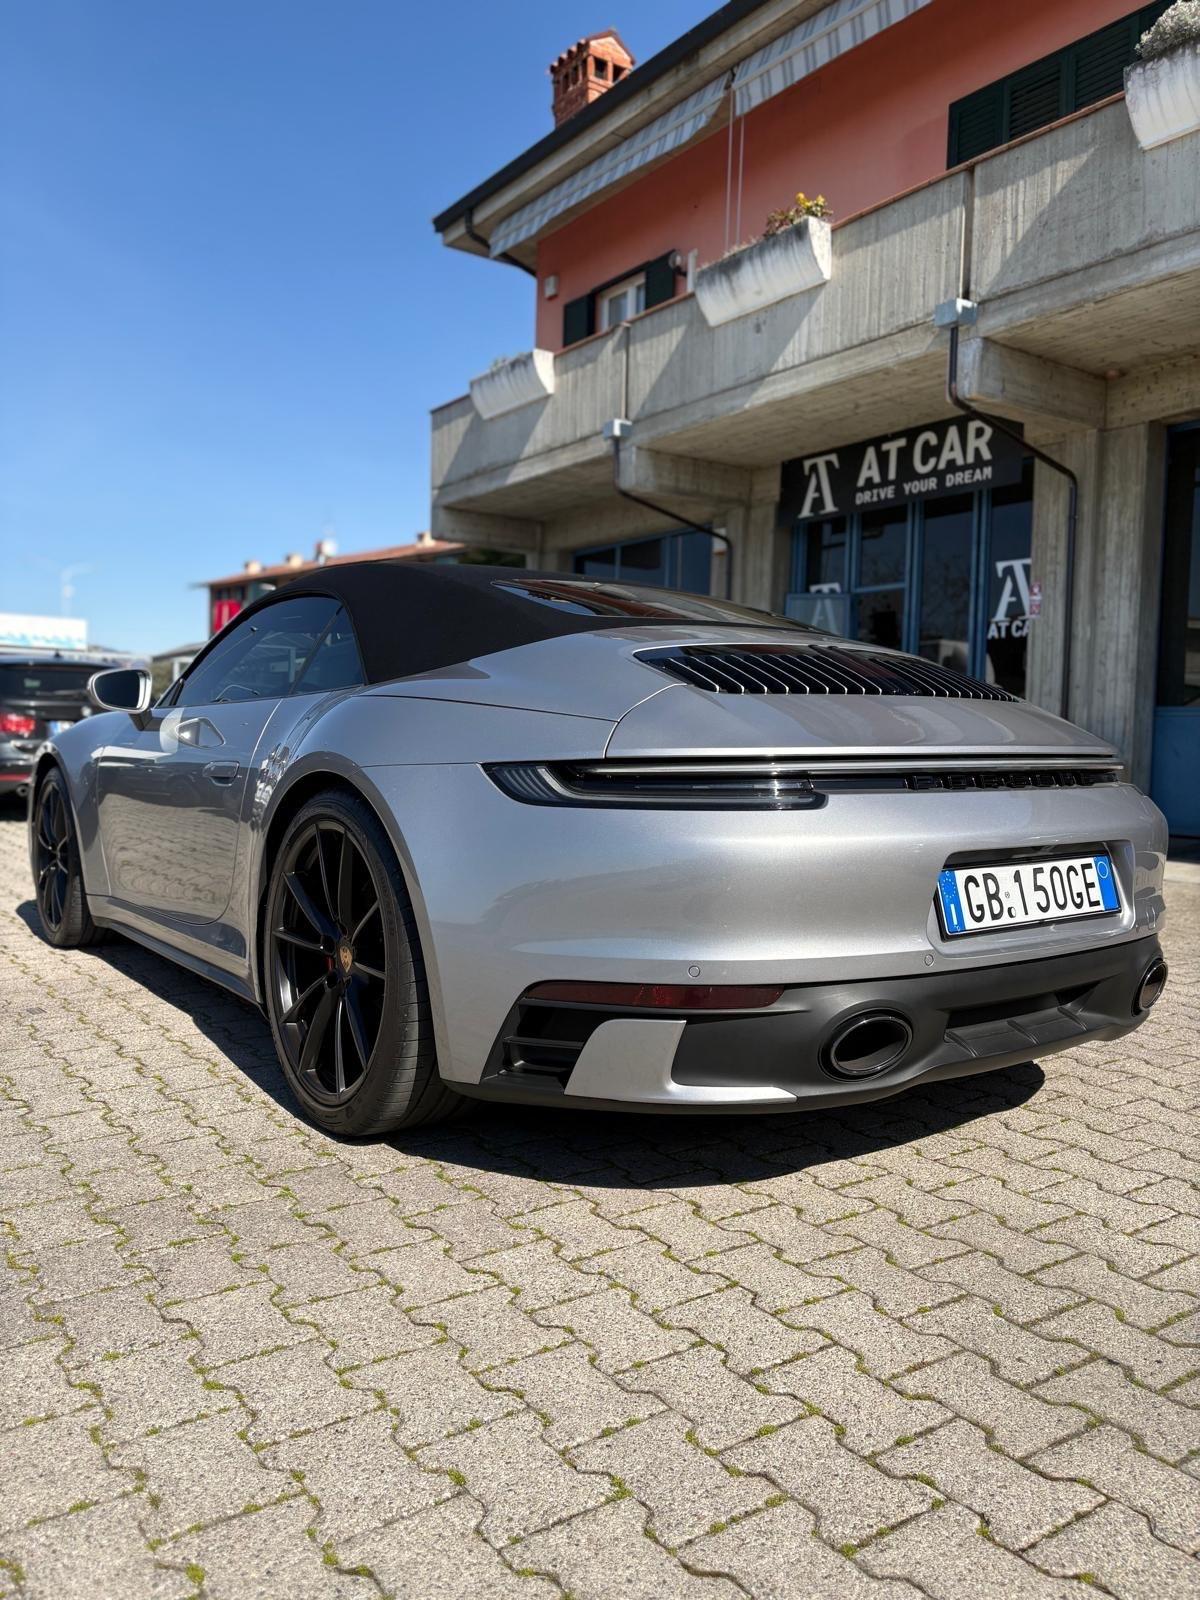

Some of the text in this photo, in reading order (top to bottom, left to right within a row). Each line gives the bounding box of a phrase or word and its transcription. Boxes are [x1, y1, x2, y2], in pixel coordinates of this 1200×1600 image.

[857, 419, 993, 488] AT CAR
[855, 465, 993, 506] DRIVE YOUR DREAM
[987, 621, 1010, 640] AT
